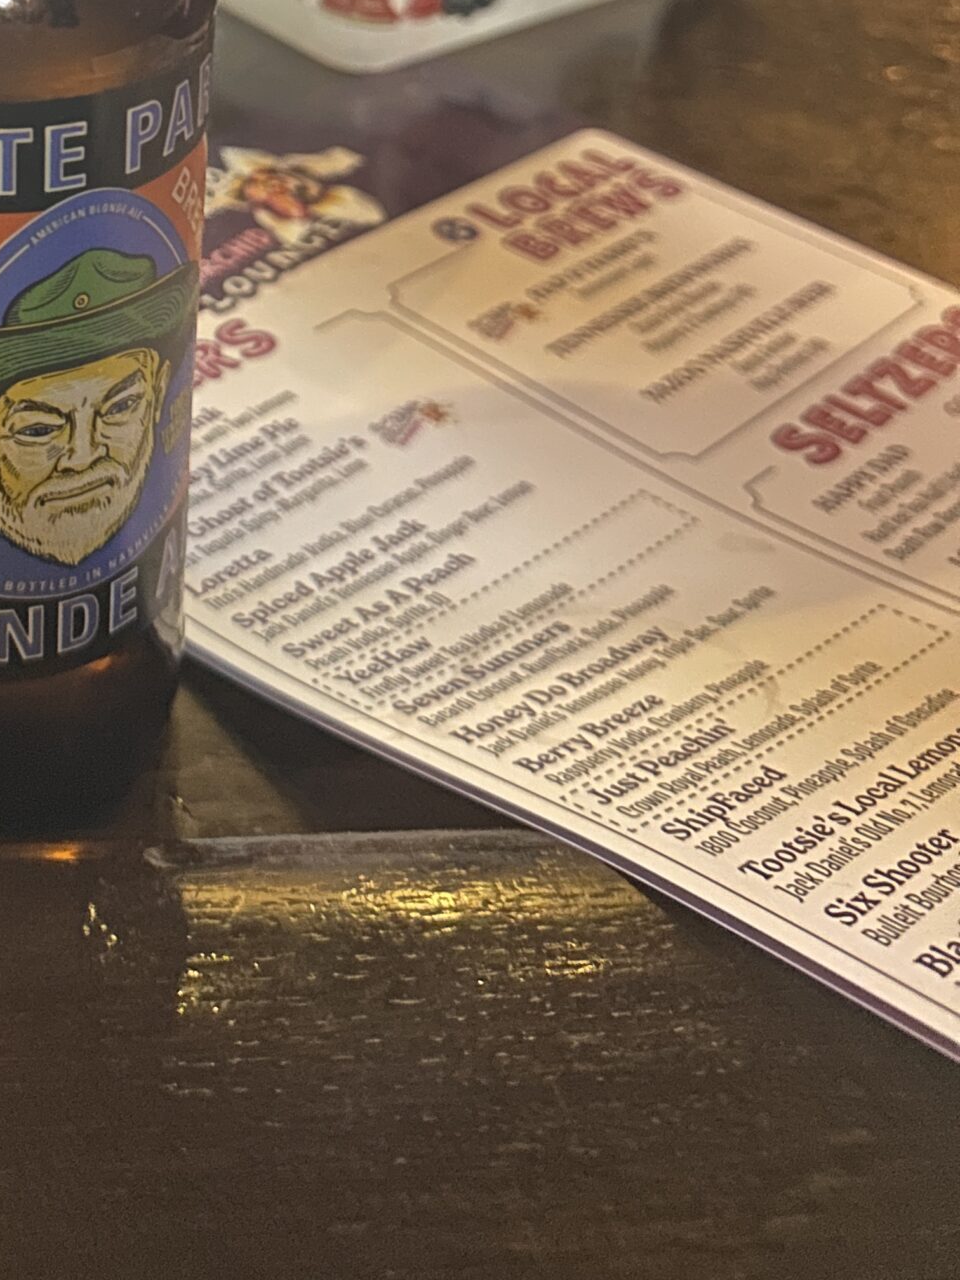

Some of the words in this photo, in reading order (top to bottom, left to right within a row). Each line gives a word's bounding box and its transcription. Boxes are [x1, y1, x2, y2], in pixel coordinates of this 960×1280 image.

[463, 147, 636, 231] LOCAL
[501, 166, 685, 263] BREWS
[29, 207, 87, 246] AMERICAN
[184, 497, 254, 538] Ghost
[252, 480, 278, 503] of
[270, 436, 365, 489] Tootsie's
[4, 577, 77, 593] BOTTLED
[184, 548, 273, 597] Loretta
[231, 580, 314, 632] Spiced
[309, 548, 375, 588] Apple
[371, 519, 427, 553] Jack
[237, 551, 309, 593] Handmade
[281, 595, 339, 627] Daniel's
[329, 560, 401, 600] Tennessee
[281, 617, 359, 662] Sweet
[353, 600, 391, 624] As
[384, 588, 411, 607] A
[401, 553, 475, 595] Peach
[303, 646, 360, 675] Peach
[343, 620, 396, 651] Vodka,
[333, 630, 431, 689] YeeHaw
[358, 674, 419, 703] Firefly
[399, 647, 449, 679] Sweet
[438, 641, 472, 657] Tea
[461, 621, 509, 648] Vodka
[507, 582, 573, 621] Lemonade
[392, 670, 471, 720] Seven
[450, 615, 570, 681] Summers
[416, 693, 475, 729] Bacardi
[466, 664, 532, 702] Coconut,
[448, 701, 536, 749] Honey
[523, 684, 567, 707] Do
[557, 627, 669, 688] Broadway
[829, 678, 850, 694] of
[836, 661, 882, 686] Sprite
[476, 732, 518, 758] Jack
[506, 710, 567, 741] Daniel's
[555, 677, 627, 715] Tennessee
[544, 745, 622, 792] Raspberry
[607, 725, 662, 752] Vodka,
[647, 693, 719, 728] Cranberry,
[704, 659, 769, 696] Pineapple
[788, 689, 839, 716] Splash
[884, 719, 908, 737] of
[892, 689, 959, 728] Grenadine
[513, 734, 593, 777] Berry
[578, 695, 663, 739] Breeze
[587, 771, 649, 805] Just
[634, 716, 734, 776] Peachin'
[731, 713, 804, 751] Lemonade,
[840, 731, 895, 761] Splash
[657, 767, 706, 795] Royal
[692, 748, 747, 774] Peach,
[779, 758, 859, 800] Pineapple,
[615, 790, 671, 819] Crown
[661, 765, 786, 840] ShipFaced
[723, 796, 798, 835] Coconut,
[738, 813, 851, 880] Tootsie's
[844, 772, 908, 816] Local
[694, 829, 740, 856] 1800
[773, 872, 824, 903] Jack
[805, 837, 872, 878] Daniel's
[854, 818, 895, 842] Old
[875, 808, 916, 827] No.
[900, 798, 929, 811] 7,
[824, 891, 882, 927] Six
[862, 828, 960, 896] Shooter
[860, 903, 926, 947] Bulleit
